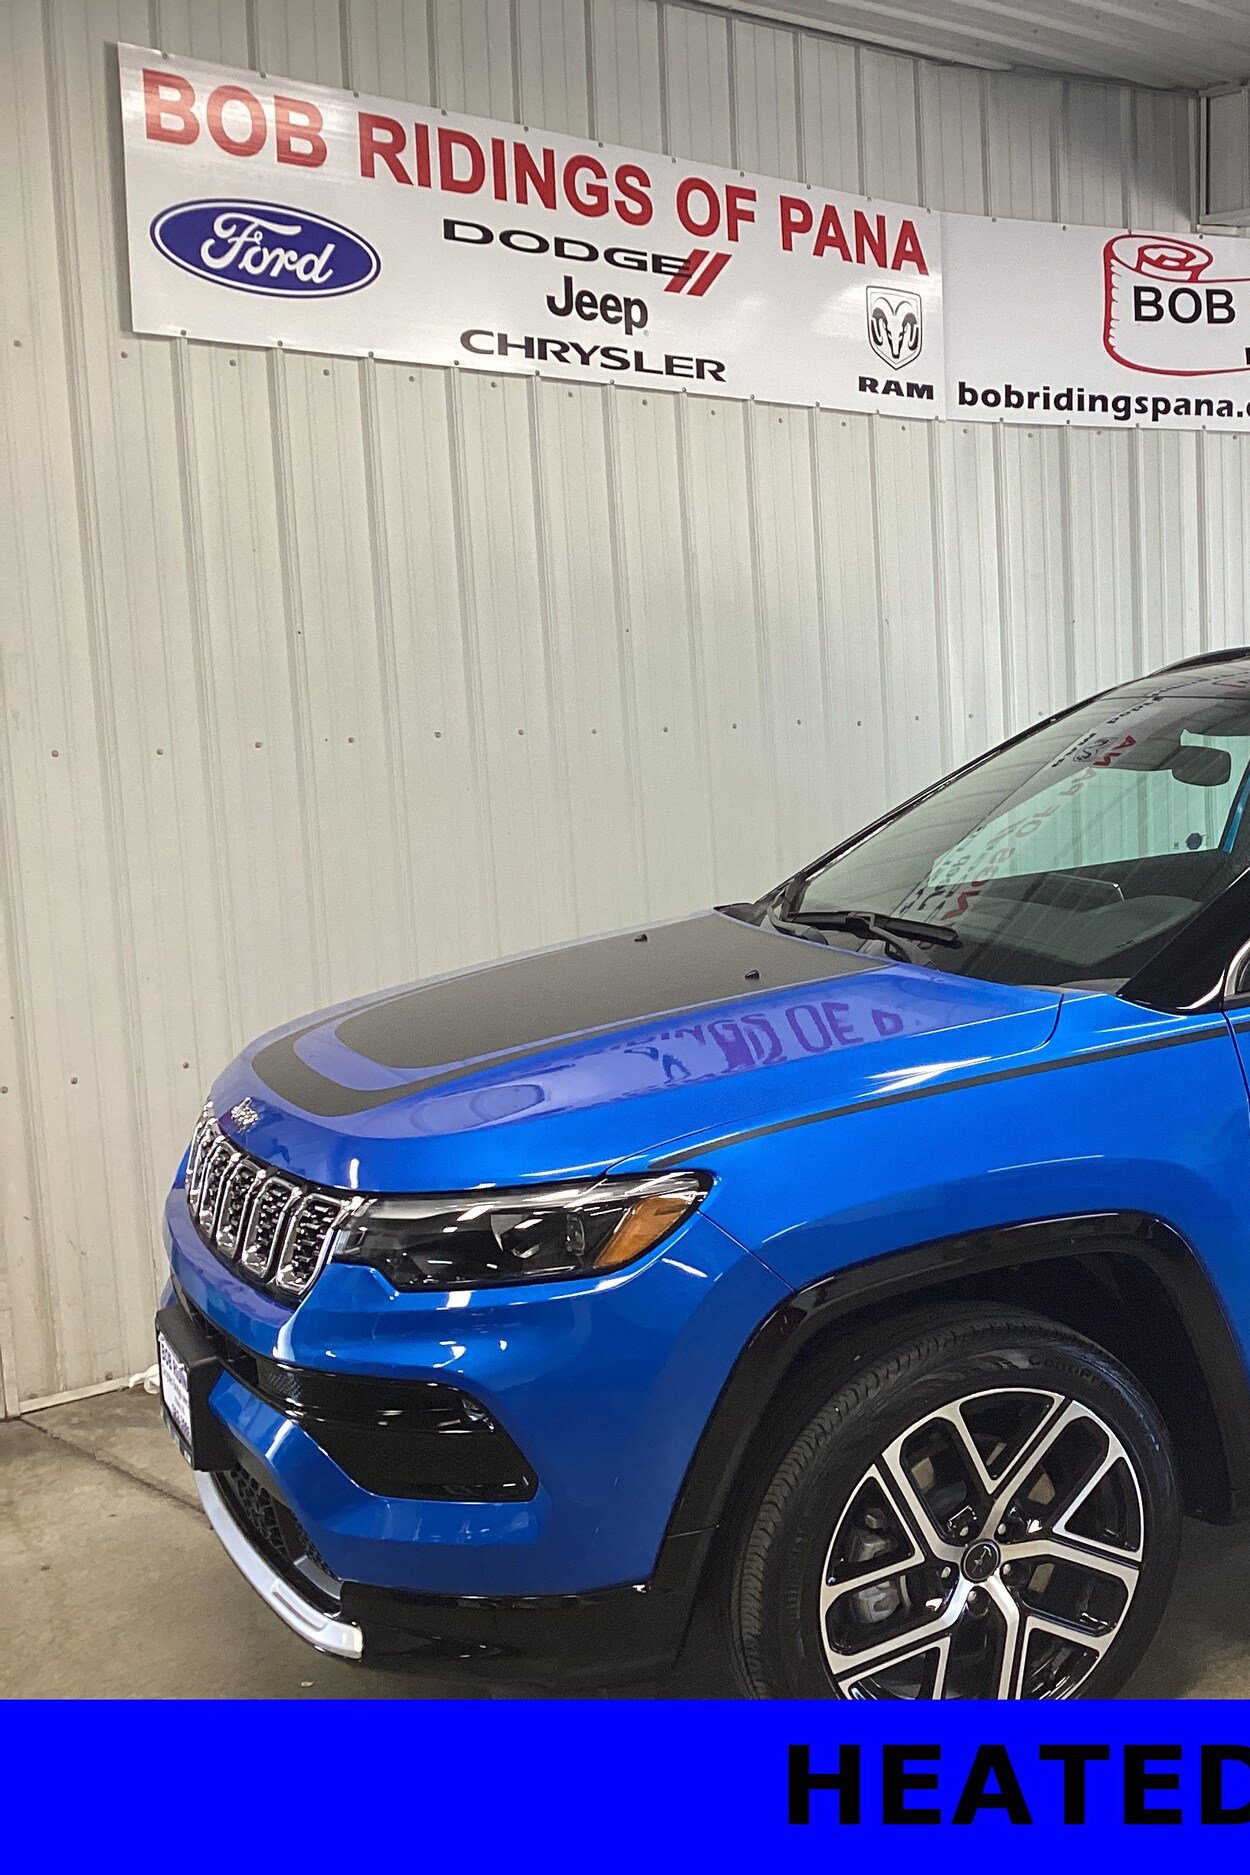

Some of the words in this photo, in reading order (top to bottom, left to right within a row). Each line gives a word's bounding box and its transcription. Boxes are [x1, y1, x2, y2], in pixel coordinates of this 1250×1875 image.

[142, 68, 328, 169] BOB
[358, 112, 654, 227] RIDINGS
[676, 177, 757, 243] OF
[779, 195, 929, 276] PANA
[200, 212, 336, 284] Ford
[443, 218, 693, 279] DODGE
[546, 275, 648, 336] Jeep
[1133, 285, 1236, 324] BOB
[460, 329, 727, 383] CHRYSLER
[858, 376, 934, 401] RAM
